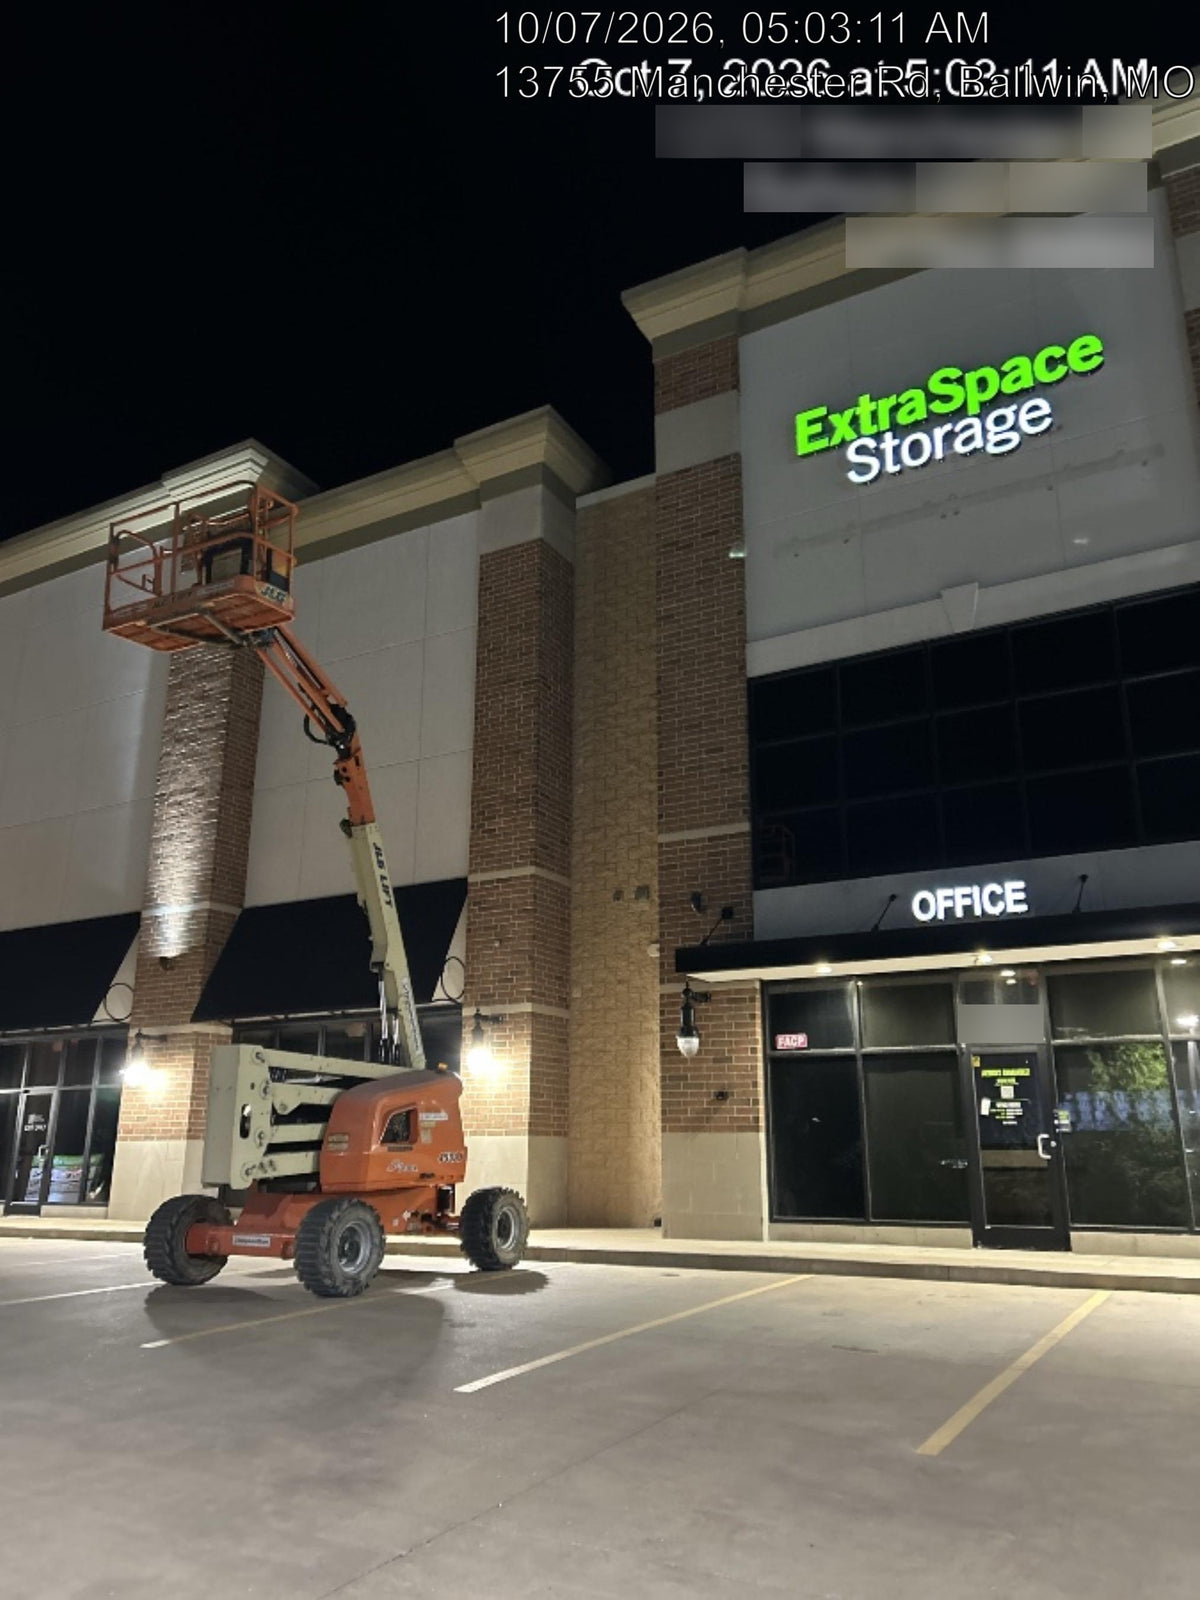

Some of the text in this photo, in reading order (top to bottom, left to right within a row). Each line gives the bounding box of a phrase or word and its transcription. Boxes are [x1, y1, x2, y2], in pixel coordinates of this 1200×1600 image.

[795, 334, 1105, 456] ExtraSpace
[846, 397, 1053, 484] Storage
[911, 880, 1029, 922] OFFICE
